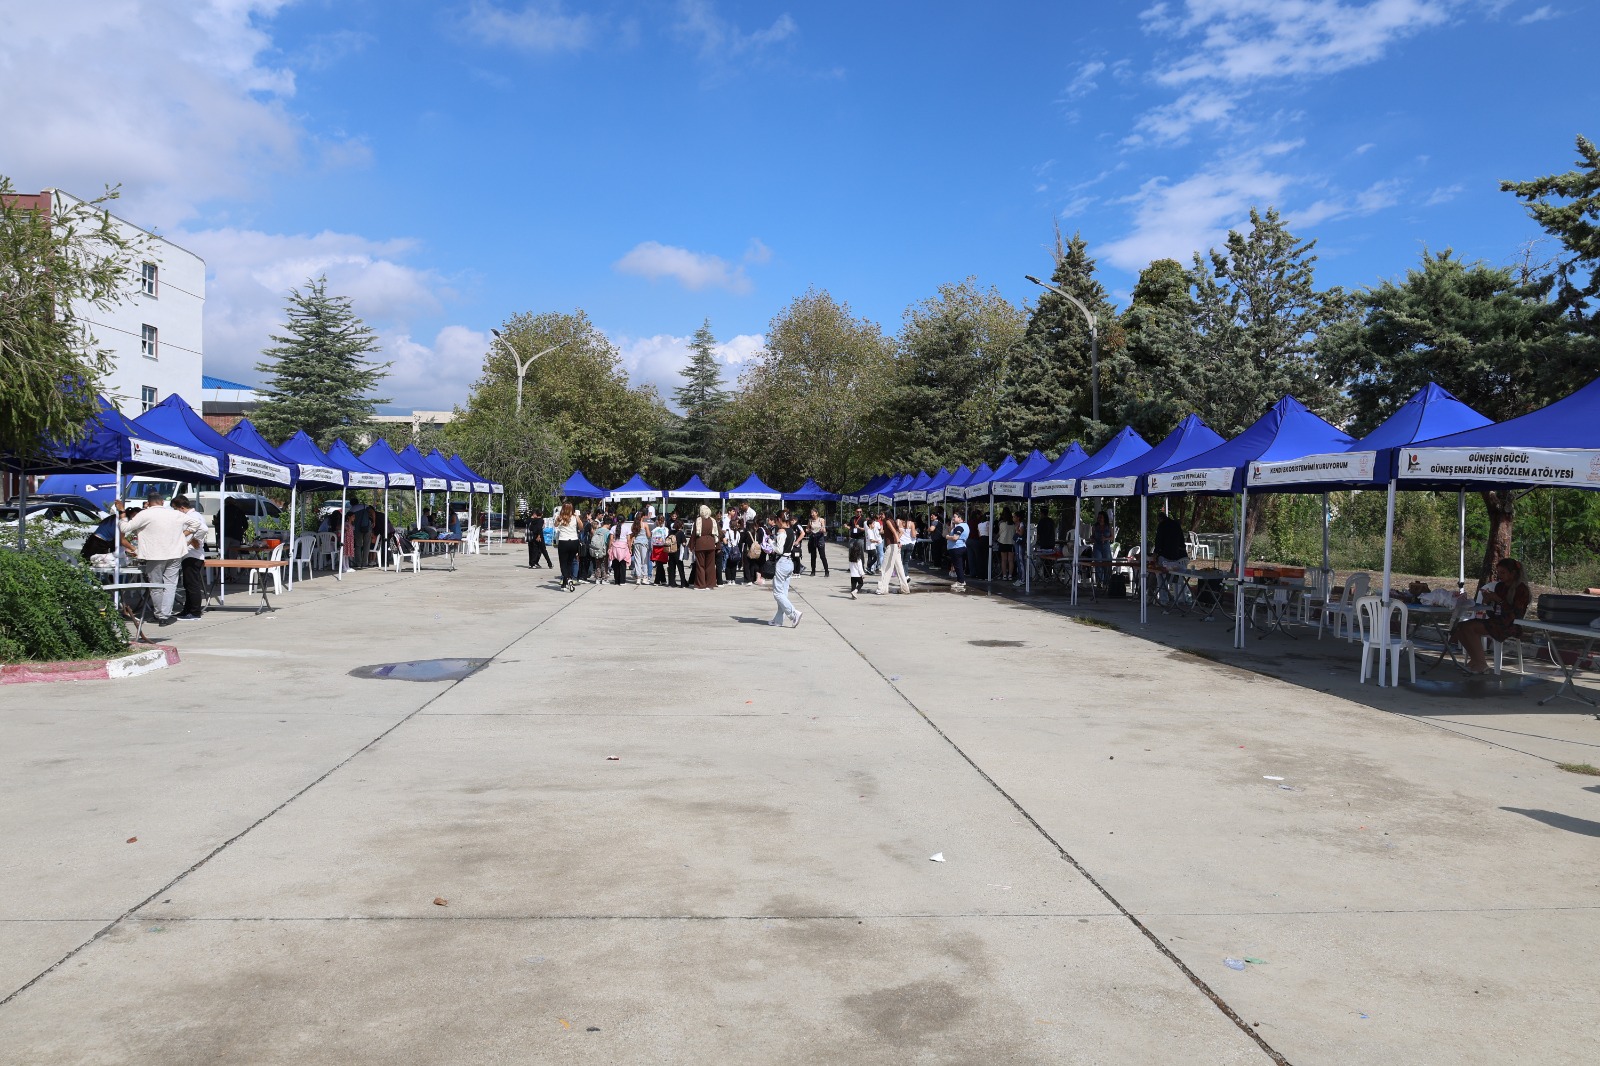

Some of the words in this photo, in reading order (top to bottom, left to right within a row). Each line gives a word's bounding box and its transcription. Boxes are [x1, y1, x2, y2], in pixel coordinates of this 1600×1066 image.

[1315, 461, 1348, 470] KURUYORUM
[1468, 452, 1502, 466] GÜNEŞİN
[1503, 452, 1529, 464] GÜCÜ:
[1430, 463, 1453, 476] GÜNEŞ
[1453, 464, 1486, 475] ENERJİSİ
[1487, 466, 1496, 475] VE
[1497, 465, 1530, 477] GÖZLEM
[1531, 467, 1574, 479] ATÖLYESİ
